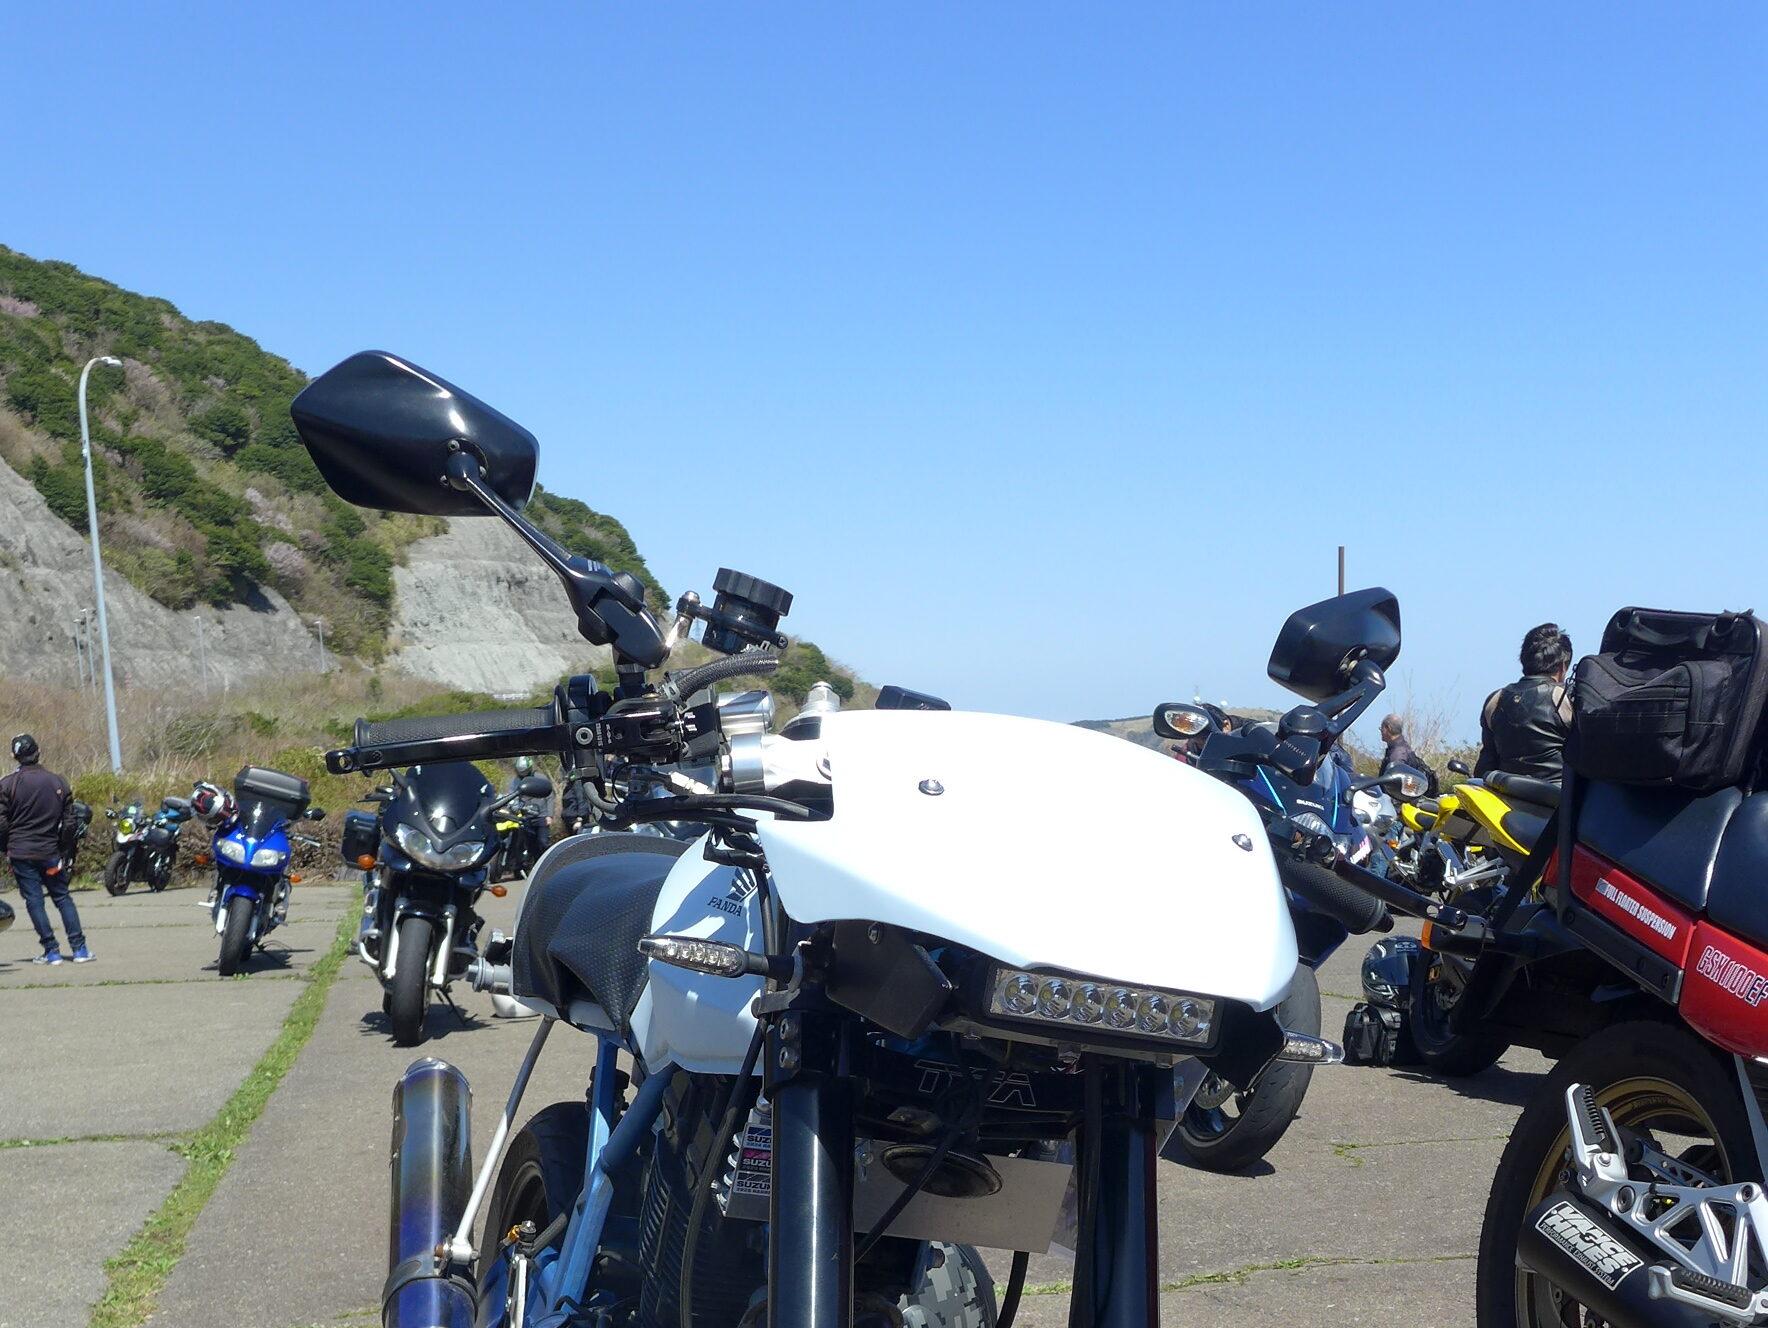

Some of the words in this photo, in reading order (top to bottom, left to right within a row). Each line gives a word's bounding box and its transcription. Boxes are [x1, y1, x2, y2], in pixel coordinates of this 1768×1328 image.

[707, 896, 743, 917] PANDA
[1604, 884, 1619, 902] FULL
[1614, 890, 1641, 917] FLOATER
[1636, 905, 1677, 940] SUSPENSION
[746, 1135, 772, 1144] SUZ
[1539, 1222, 1574, 1253] PERFORMANCE
[1572, 1249, 1598, 1271] EXHAUST
[1595, 1267, 1615, 1286] SYSTEM
[1544, 1214, 1621, 1275] HINES
[1557, 1206, 1638, 1267] VANCE
